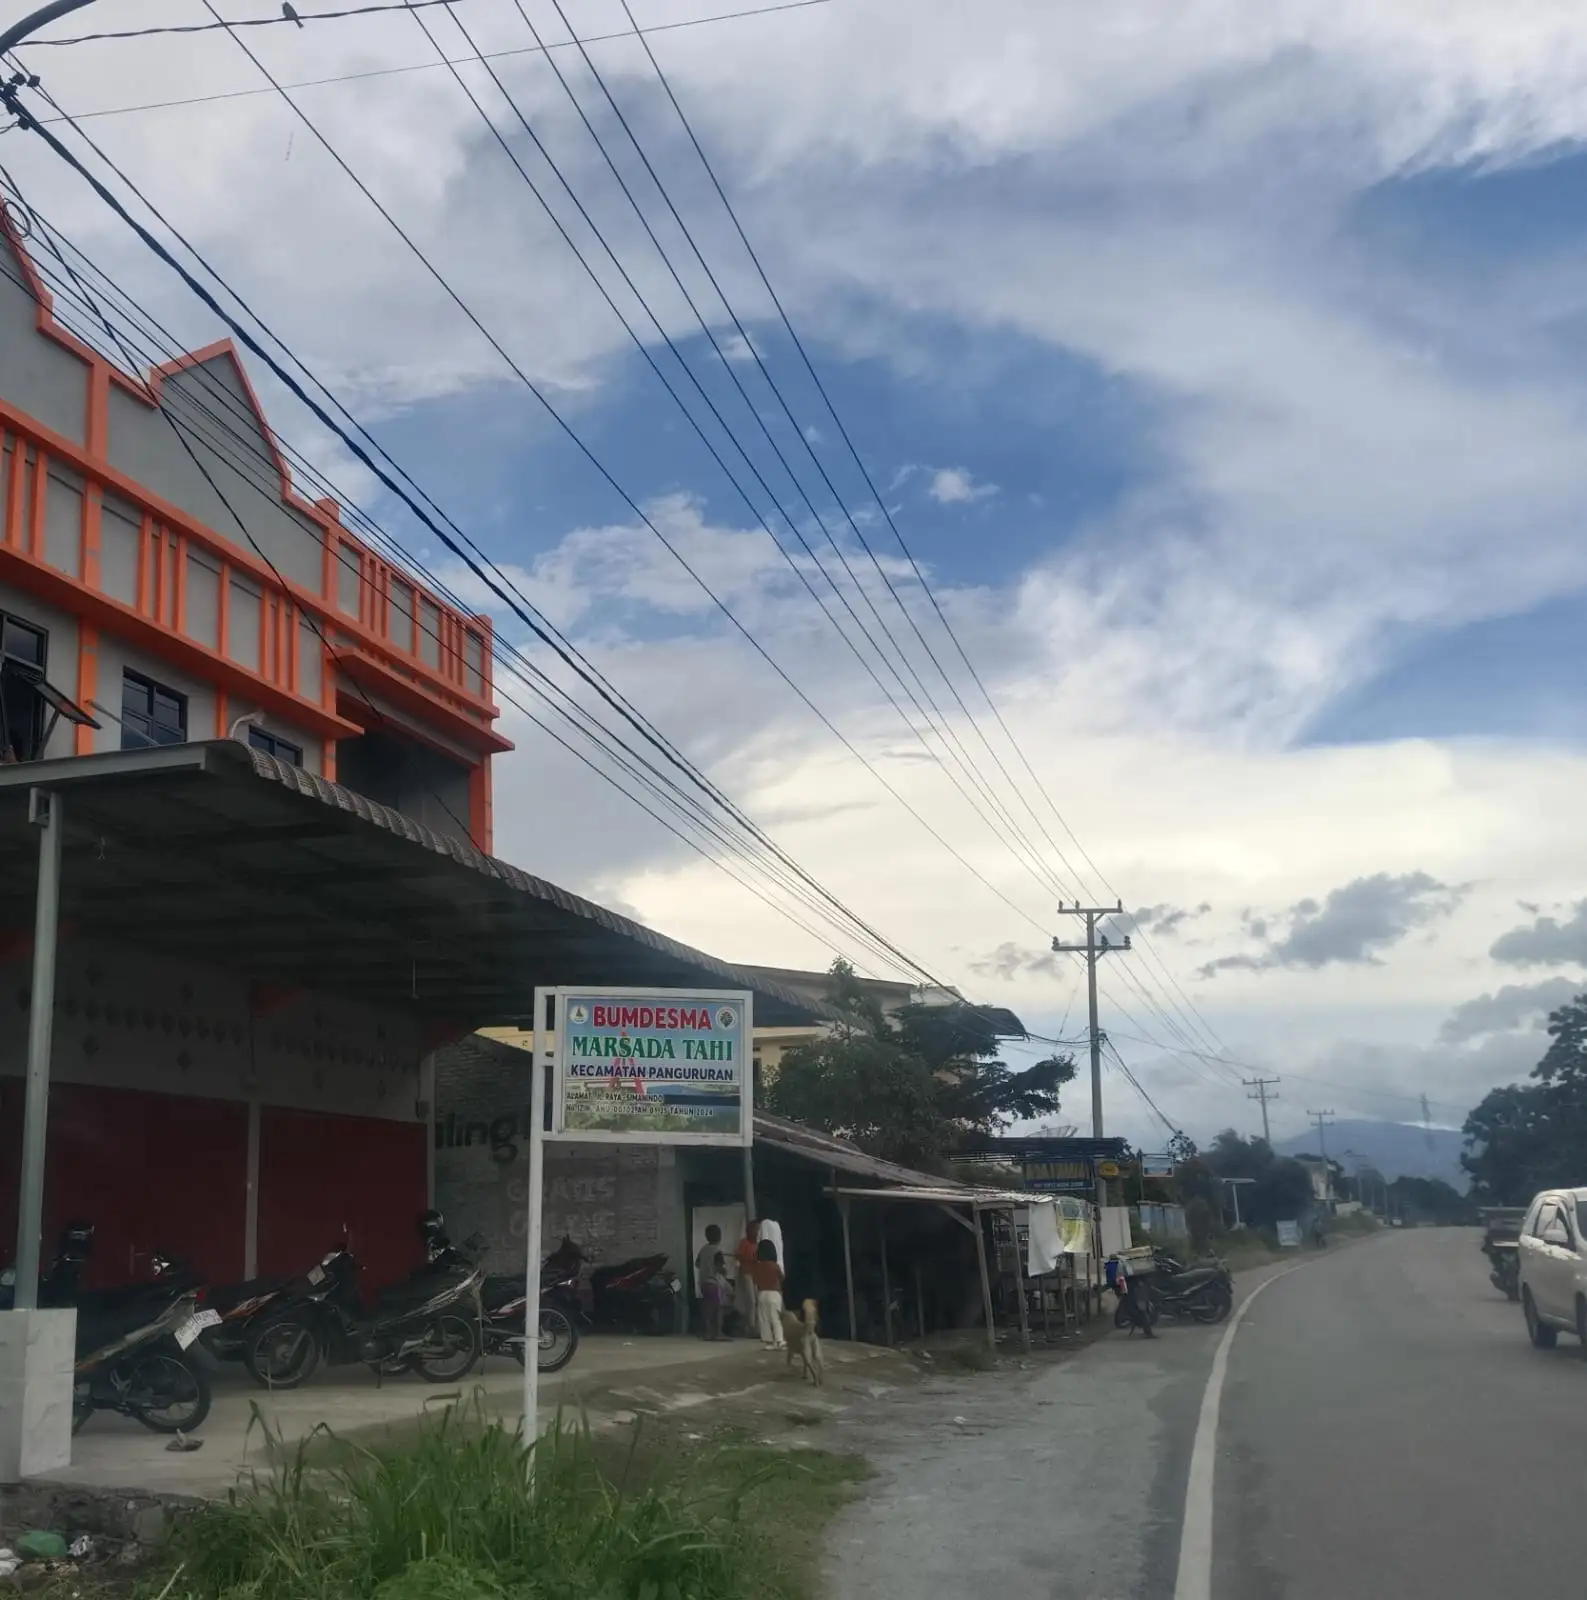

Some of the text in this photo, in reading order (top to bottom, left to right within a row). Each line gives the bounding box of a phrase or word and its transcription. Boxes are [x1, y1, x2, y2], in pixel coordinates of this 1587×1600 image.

[592, 1005, 713, 1031] BUMDESMA
[572, 1035, 733, 1062] MARSADA TAHI
[570, 1064, 734, 1082] KECAMATAN PANGURURAN
[435, 1112, 519, 1163] ling
